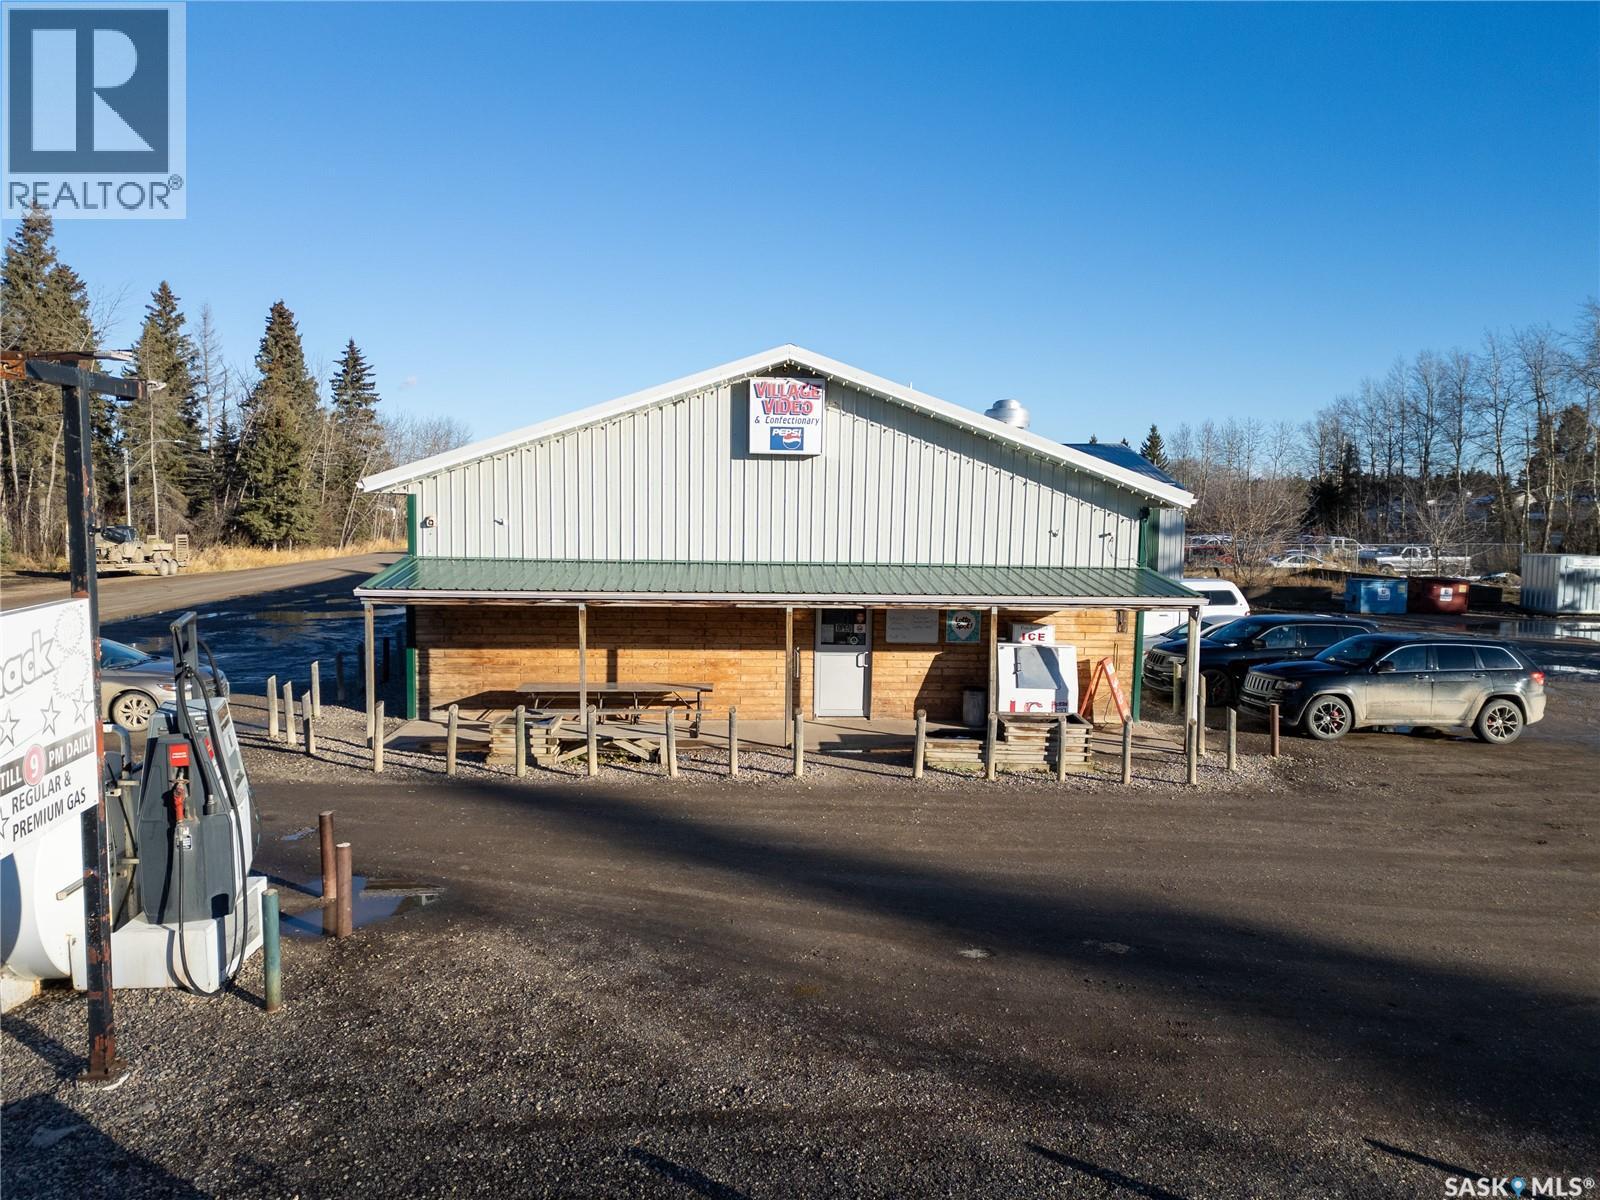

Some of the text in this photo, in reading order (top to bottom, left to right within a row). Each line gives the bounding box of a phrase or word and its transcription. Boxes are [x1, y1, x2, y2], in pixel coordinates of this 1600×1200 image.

[754, 381, 821, 400] VILLAGE
[762, 399, 814, 416] VIDEO
[754, 415, 819, 426] & Confectionary
[772, 428, 802, 436] PEPSI
[1022, 632, 1046, 641] ICE
[0, 629, 55, 699] ack
[29, 753, 39, 778] 9
[48, 746, 64, 768] PM
[66, 734, 92, 759] DAILY
[12, 770, 71, 815] REGULAR &
[13, 787, 86, 842] PREMIUM GAS
